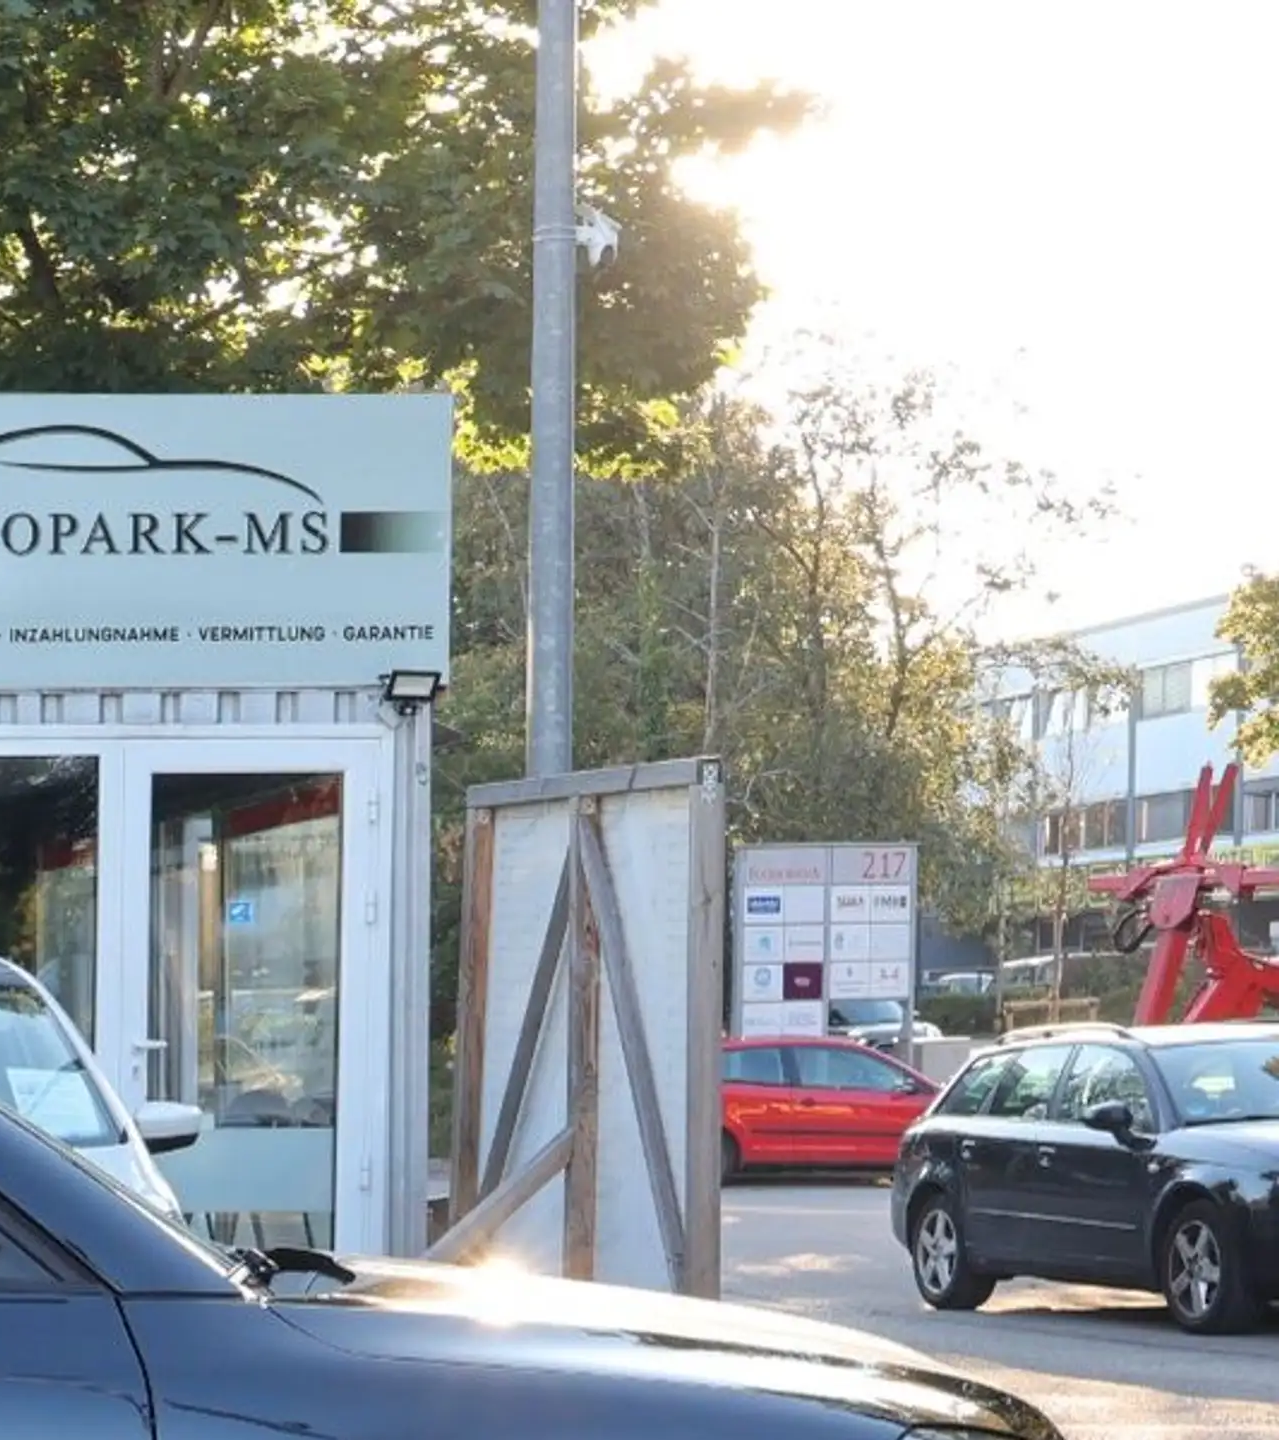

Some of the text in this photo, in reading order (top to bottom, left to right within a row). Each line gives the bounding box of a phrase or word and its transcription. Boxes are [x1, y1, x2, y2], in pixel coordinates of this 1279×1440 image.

[8, 626, 181, 643] INZAHLUNGNAHME
[198, 625, 326, 642] VERMITTLUNG
[342, 624, 435, 641] GARANTIE
[862, 852, 907, 879] 217
